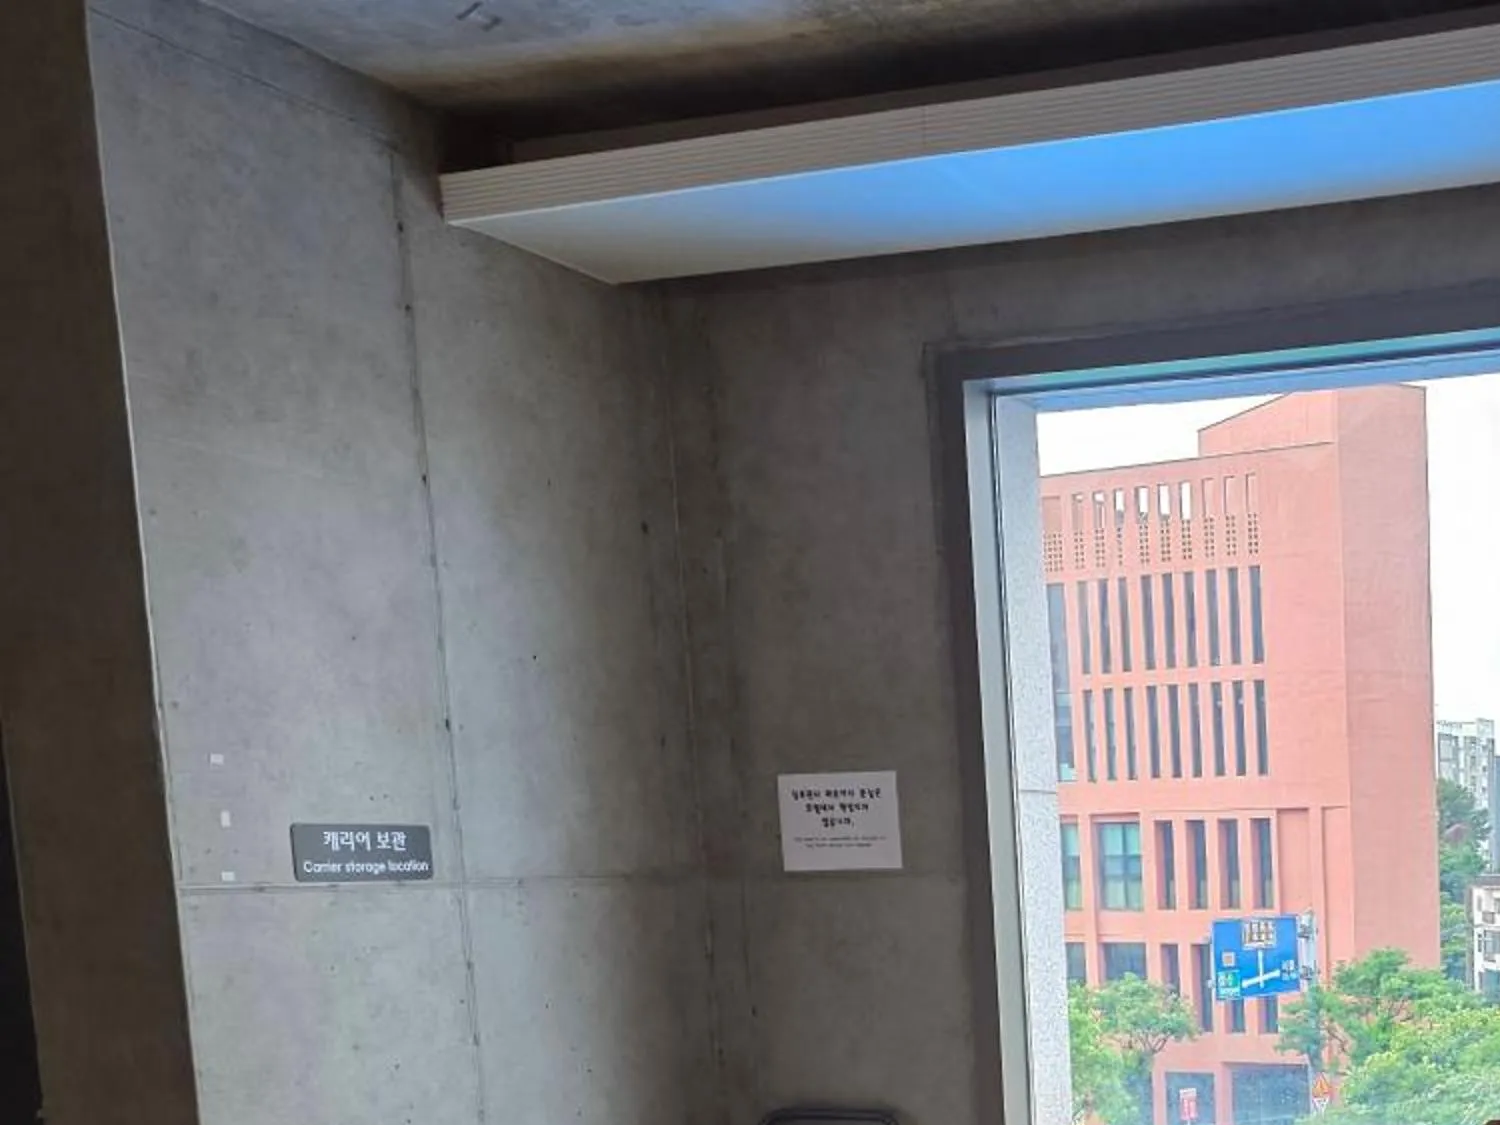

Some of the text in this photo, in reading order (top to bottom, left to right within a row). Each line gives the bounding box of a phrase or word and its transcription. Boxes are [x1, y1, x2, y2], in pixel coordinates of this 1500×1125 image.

[323, 831, 407, 852] 캐리어 보관
[303, 859, 429, 876] Carrier storage location
